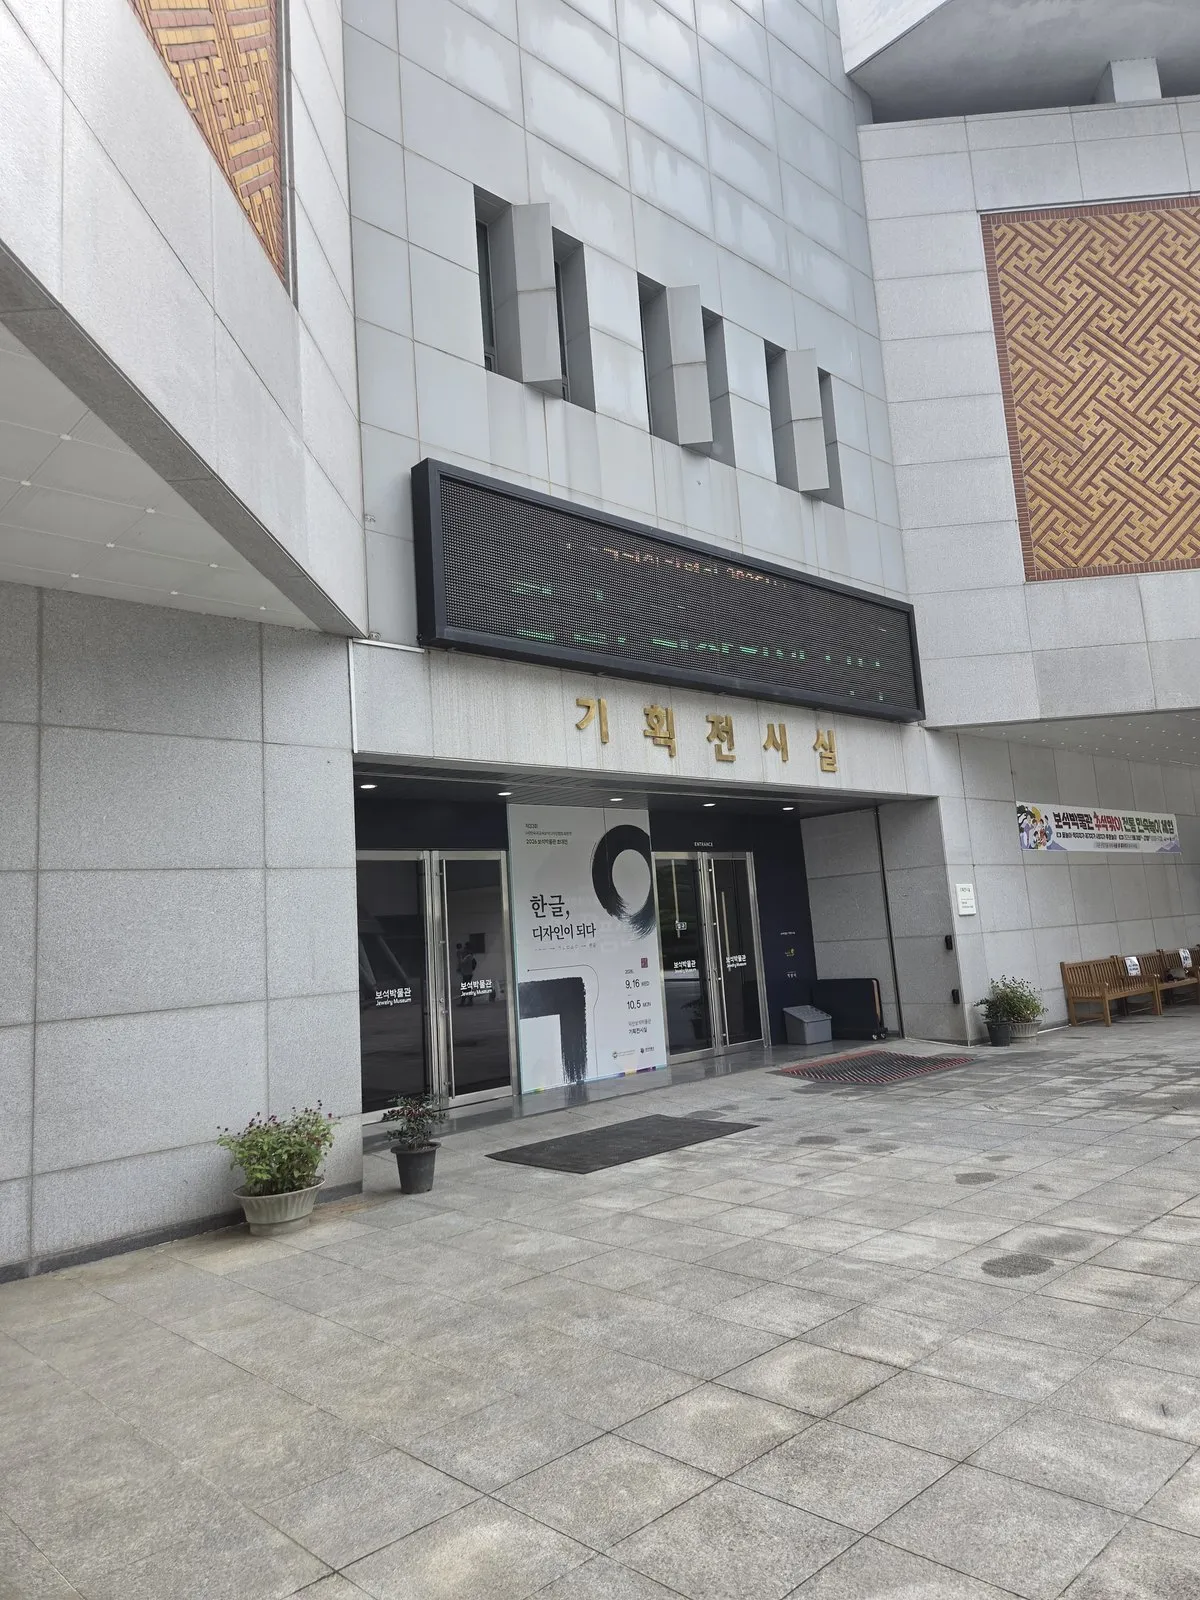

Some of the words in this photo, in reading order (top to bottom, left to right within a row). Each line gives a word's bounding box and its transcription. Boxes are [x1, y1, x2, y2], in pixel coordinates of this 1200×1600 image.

[575, 697, 838, 773] 기획전시실
[1052, 811, 1095, 831] 보석박물관
[529, 894, 570, 920] 한글,
[532, 924, 574, 942] 디자인이
[576, 922, 597, 939] 되다
[673, 959, 697, 969] 보석박물관
[460, 979, 493, 991] 보석박물관
[625, 978, 641, 989] 9.16
[375, 987, 412, 1000] 보석박물관
[460, 989, 477, 998] Jewelry
[476, 988, 493, 996] Museum
[375, 999, 394, 1007] Jewelry
[393, 997, 412, 1005] Museum
[626, 999, 642, 1010] 10.5
